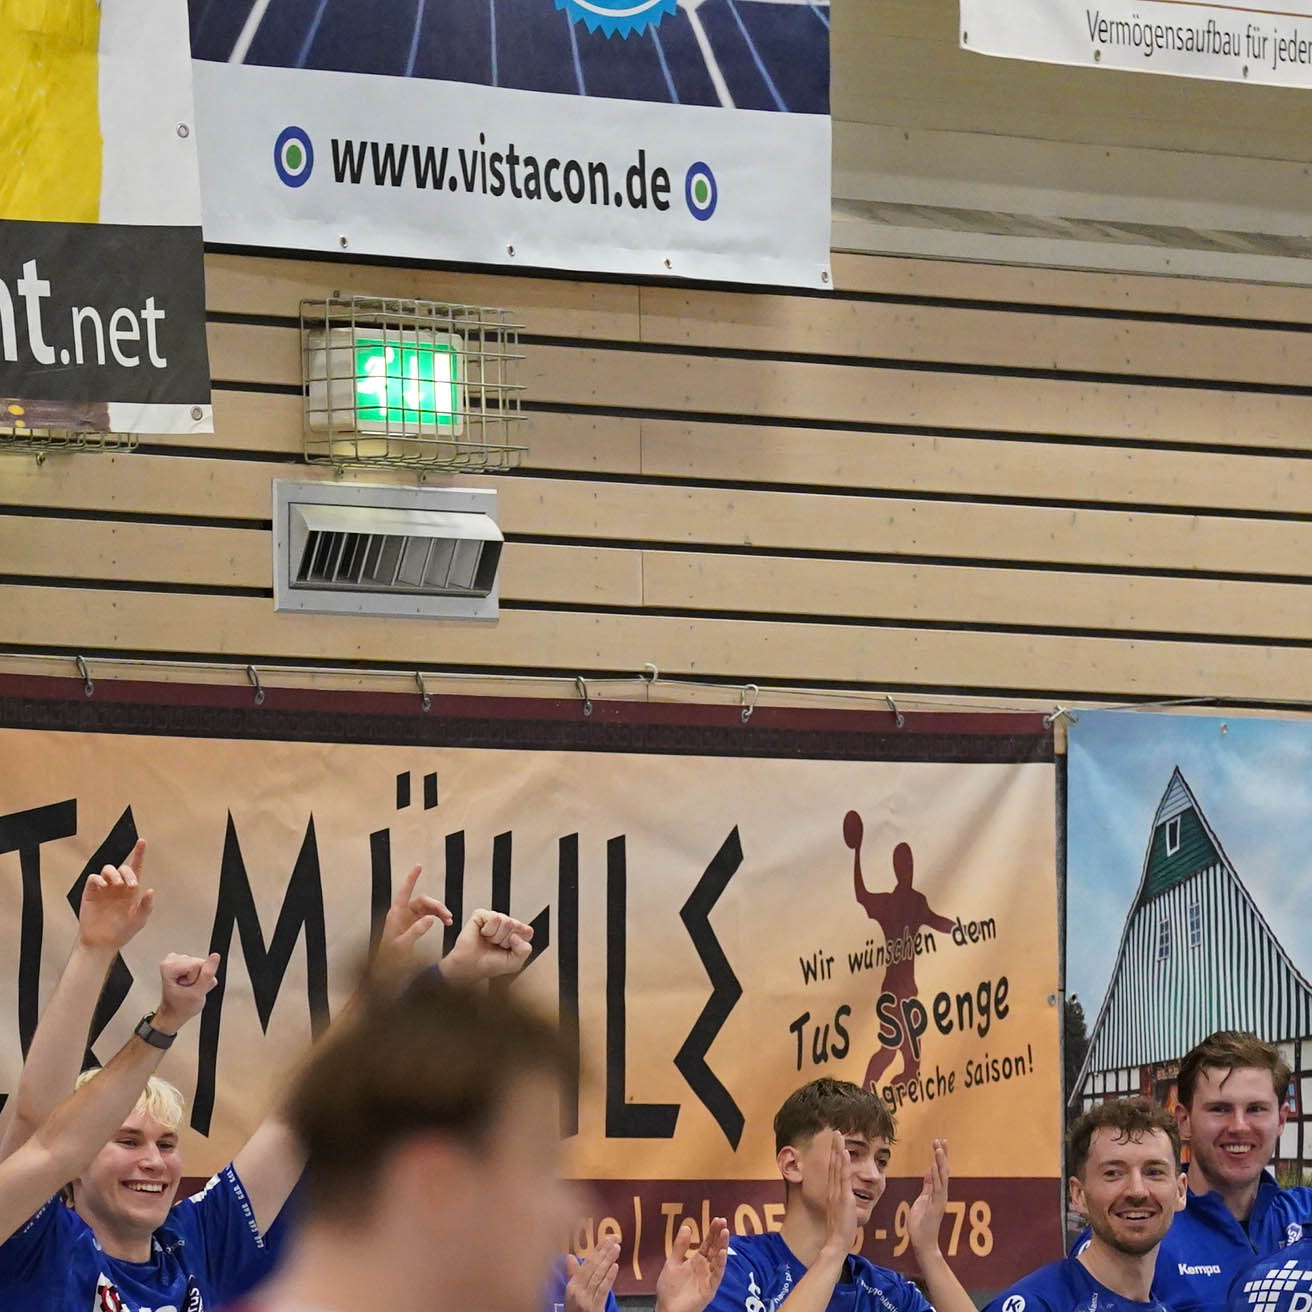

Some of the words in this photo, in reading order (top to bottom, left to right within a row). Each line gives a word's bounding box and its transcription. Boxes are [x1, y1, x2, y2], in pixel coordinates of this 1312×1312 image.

[1087, 10, 1241, 57] Vermögensaufbau
[1244, 24, 1268, 61] für
[330, 132, 672, 212] www.vistacon.de
[800, 950, 835, 986] Wir
[848, 926, 937, 974] wünschen
[952, 916, 997, 946] dem
[789, 1004, 852, 1071] TuS
[875, 976, 1010, 1061] Spenge
[964, 1044, 1034, 1088] Saison!
[1178, 1263, 1221, 1277] Kempa
